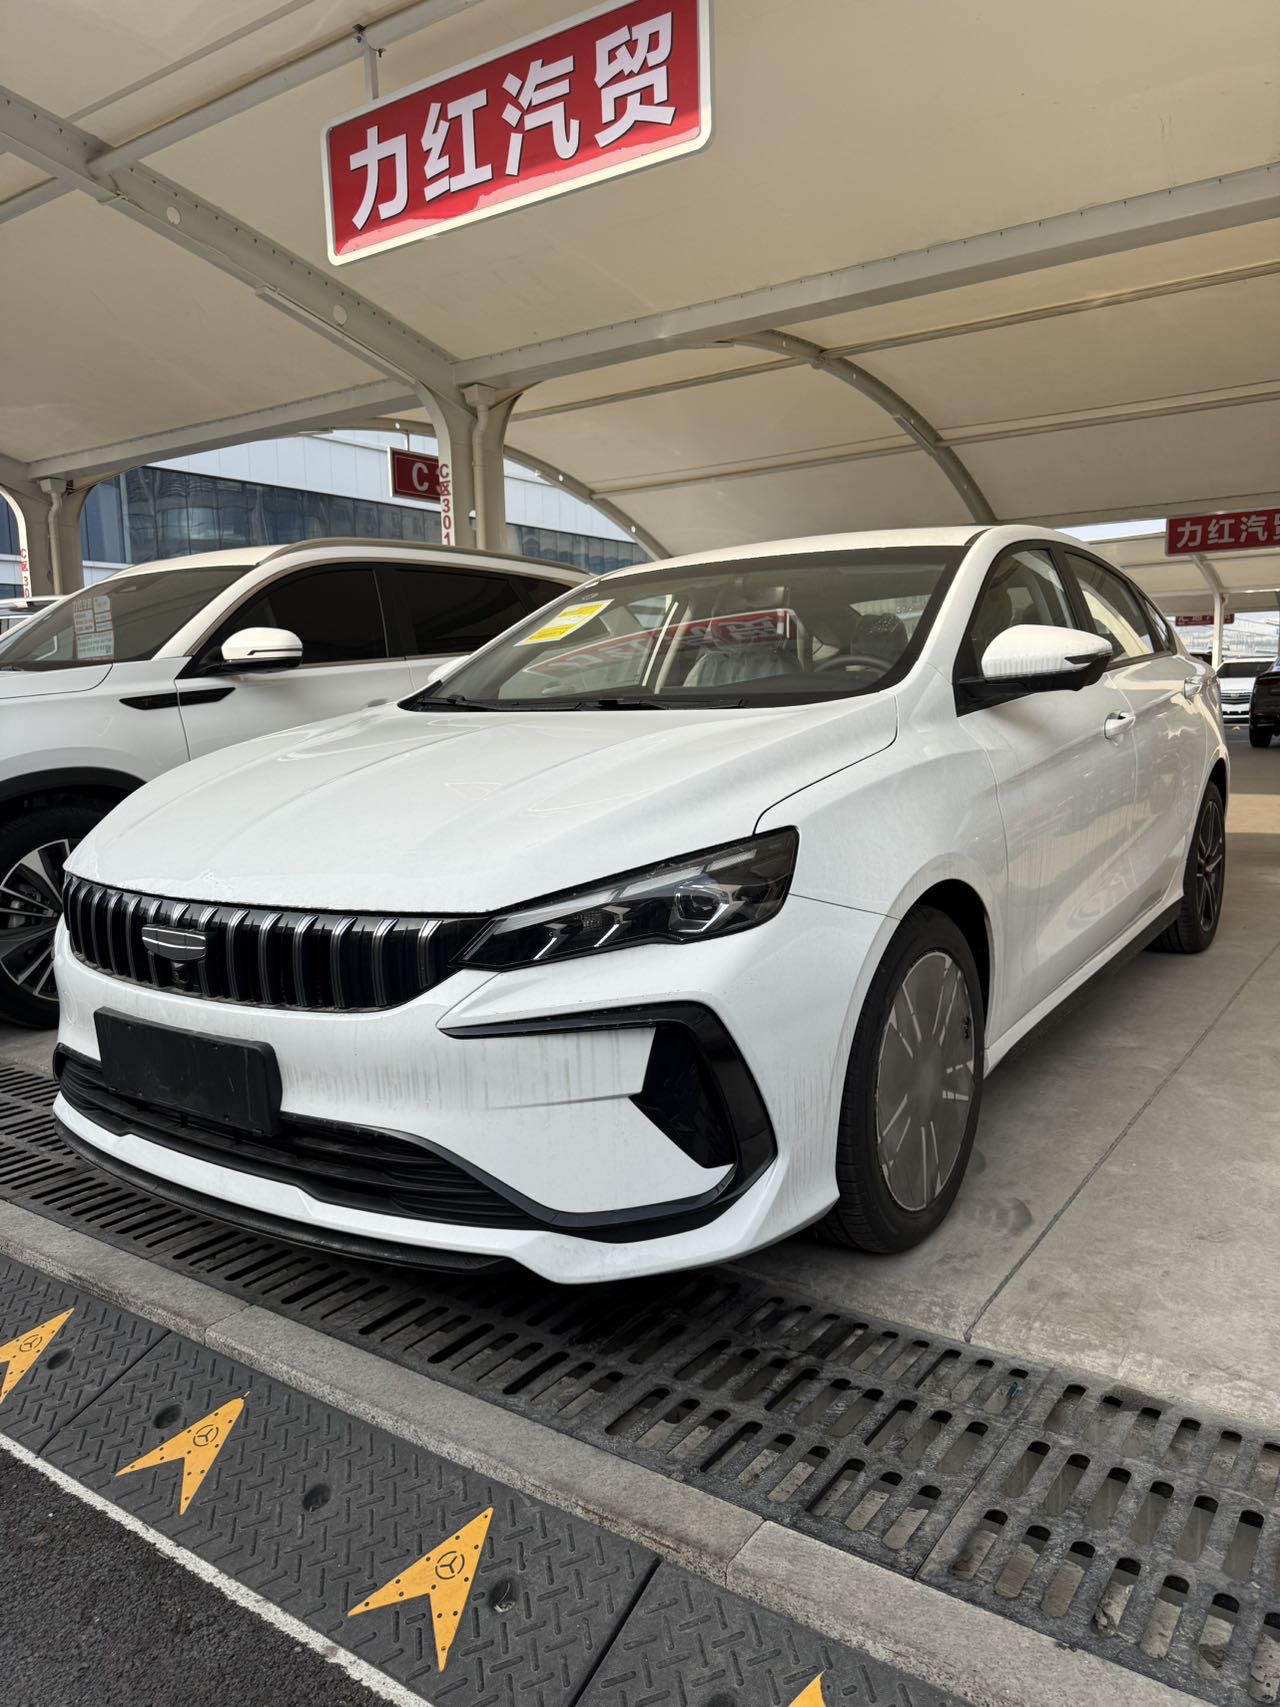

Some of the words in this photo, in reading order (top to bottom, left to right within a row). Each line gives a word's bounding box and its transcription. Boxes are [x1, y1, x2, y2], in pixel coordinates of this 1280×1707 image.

[349, 11, 676, 231] 力红汽贸
[439, 464, 452, 546] C区301
[1176, 513, 1280, 548] 力红汽
